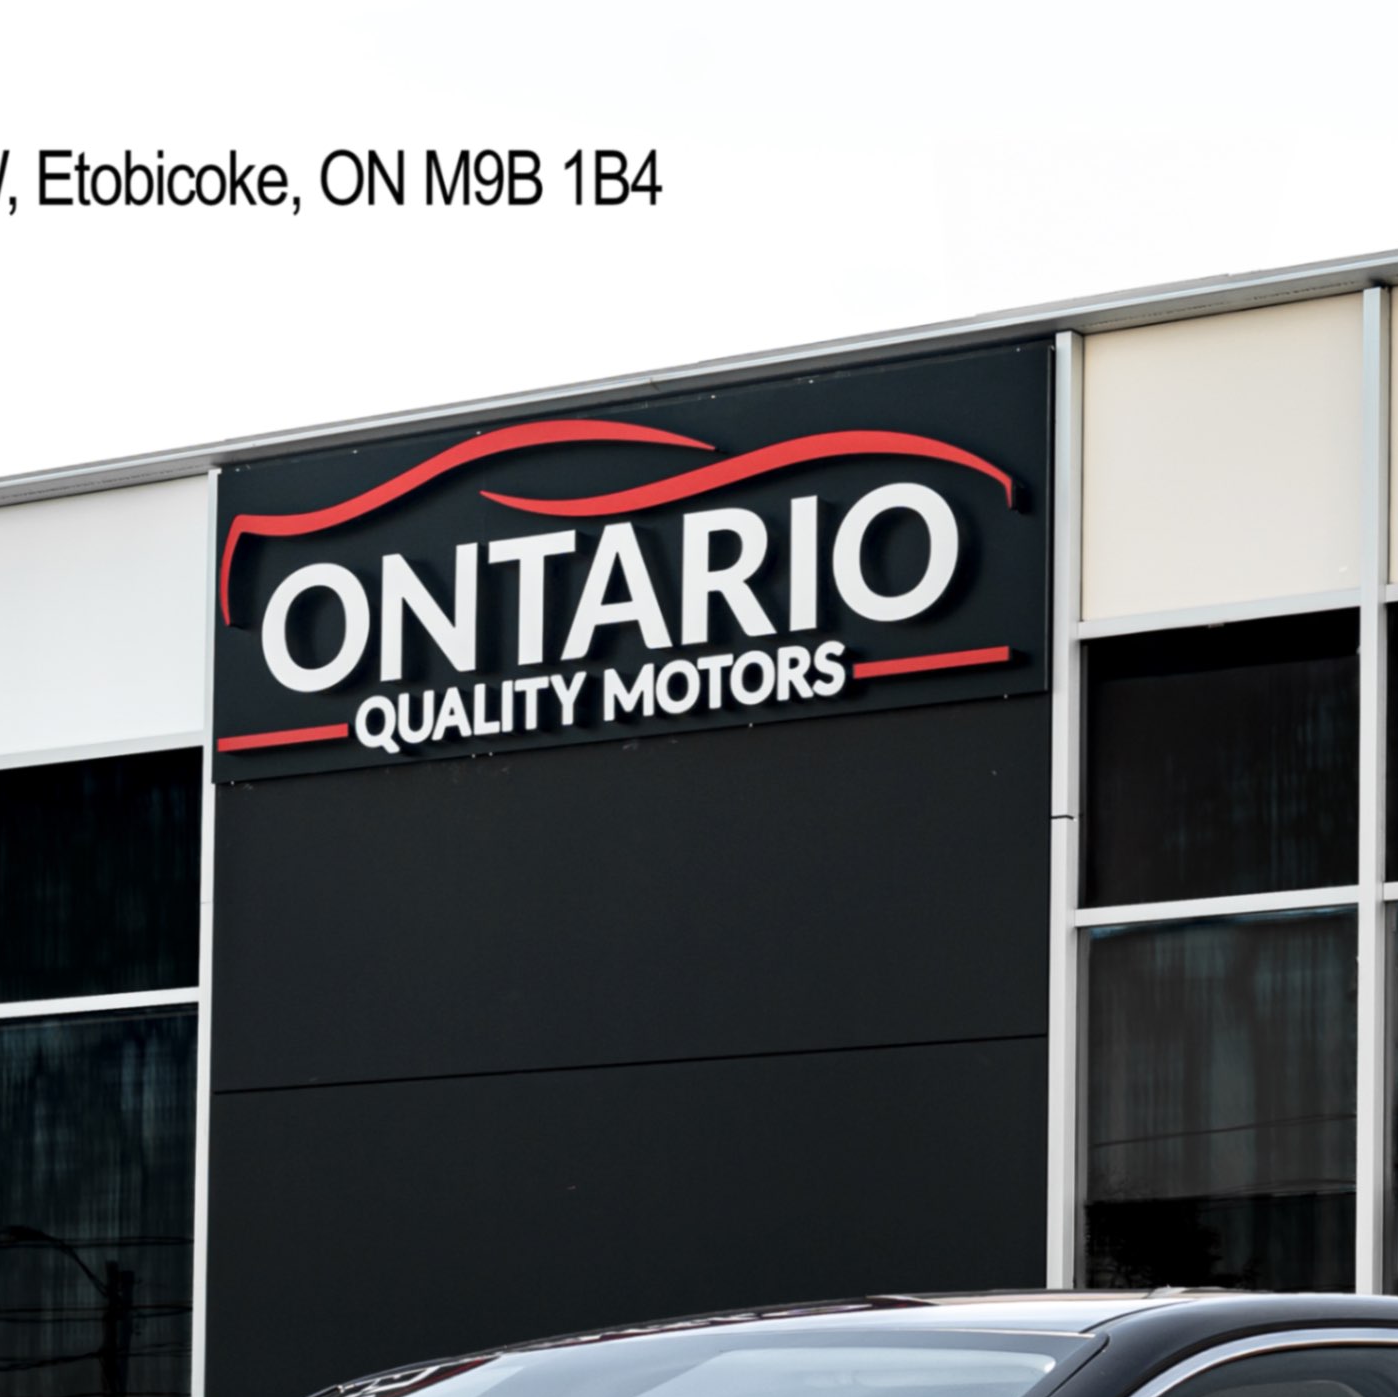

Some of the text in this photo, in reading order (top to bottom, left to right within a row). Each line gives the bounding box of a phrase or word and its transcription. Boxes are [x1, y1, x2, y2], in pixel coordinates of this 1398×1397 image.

[261, 482, 960, 694] ONTARIO
[355, 640, 847, 755] QUALITY MOTORS
